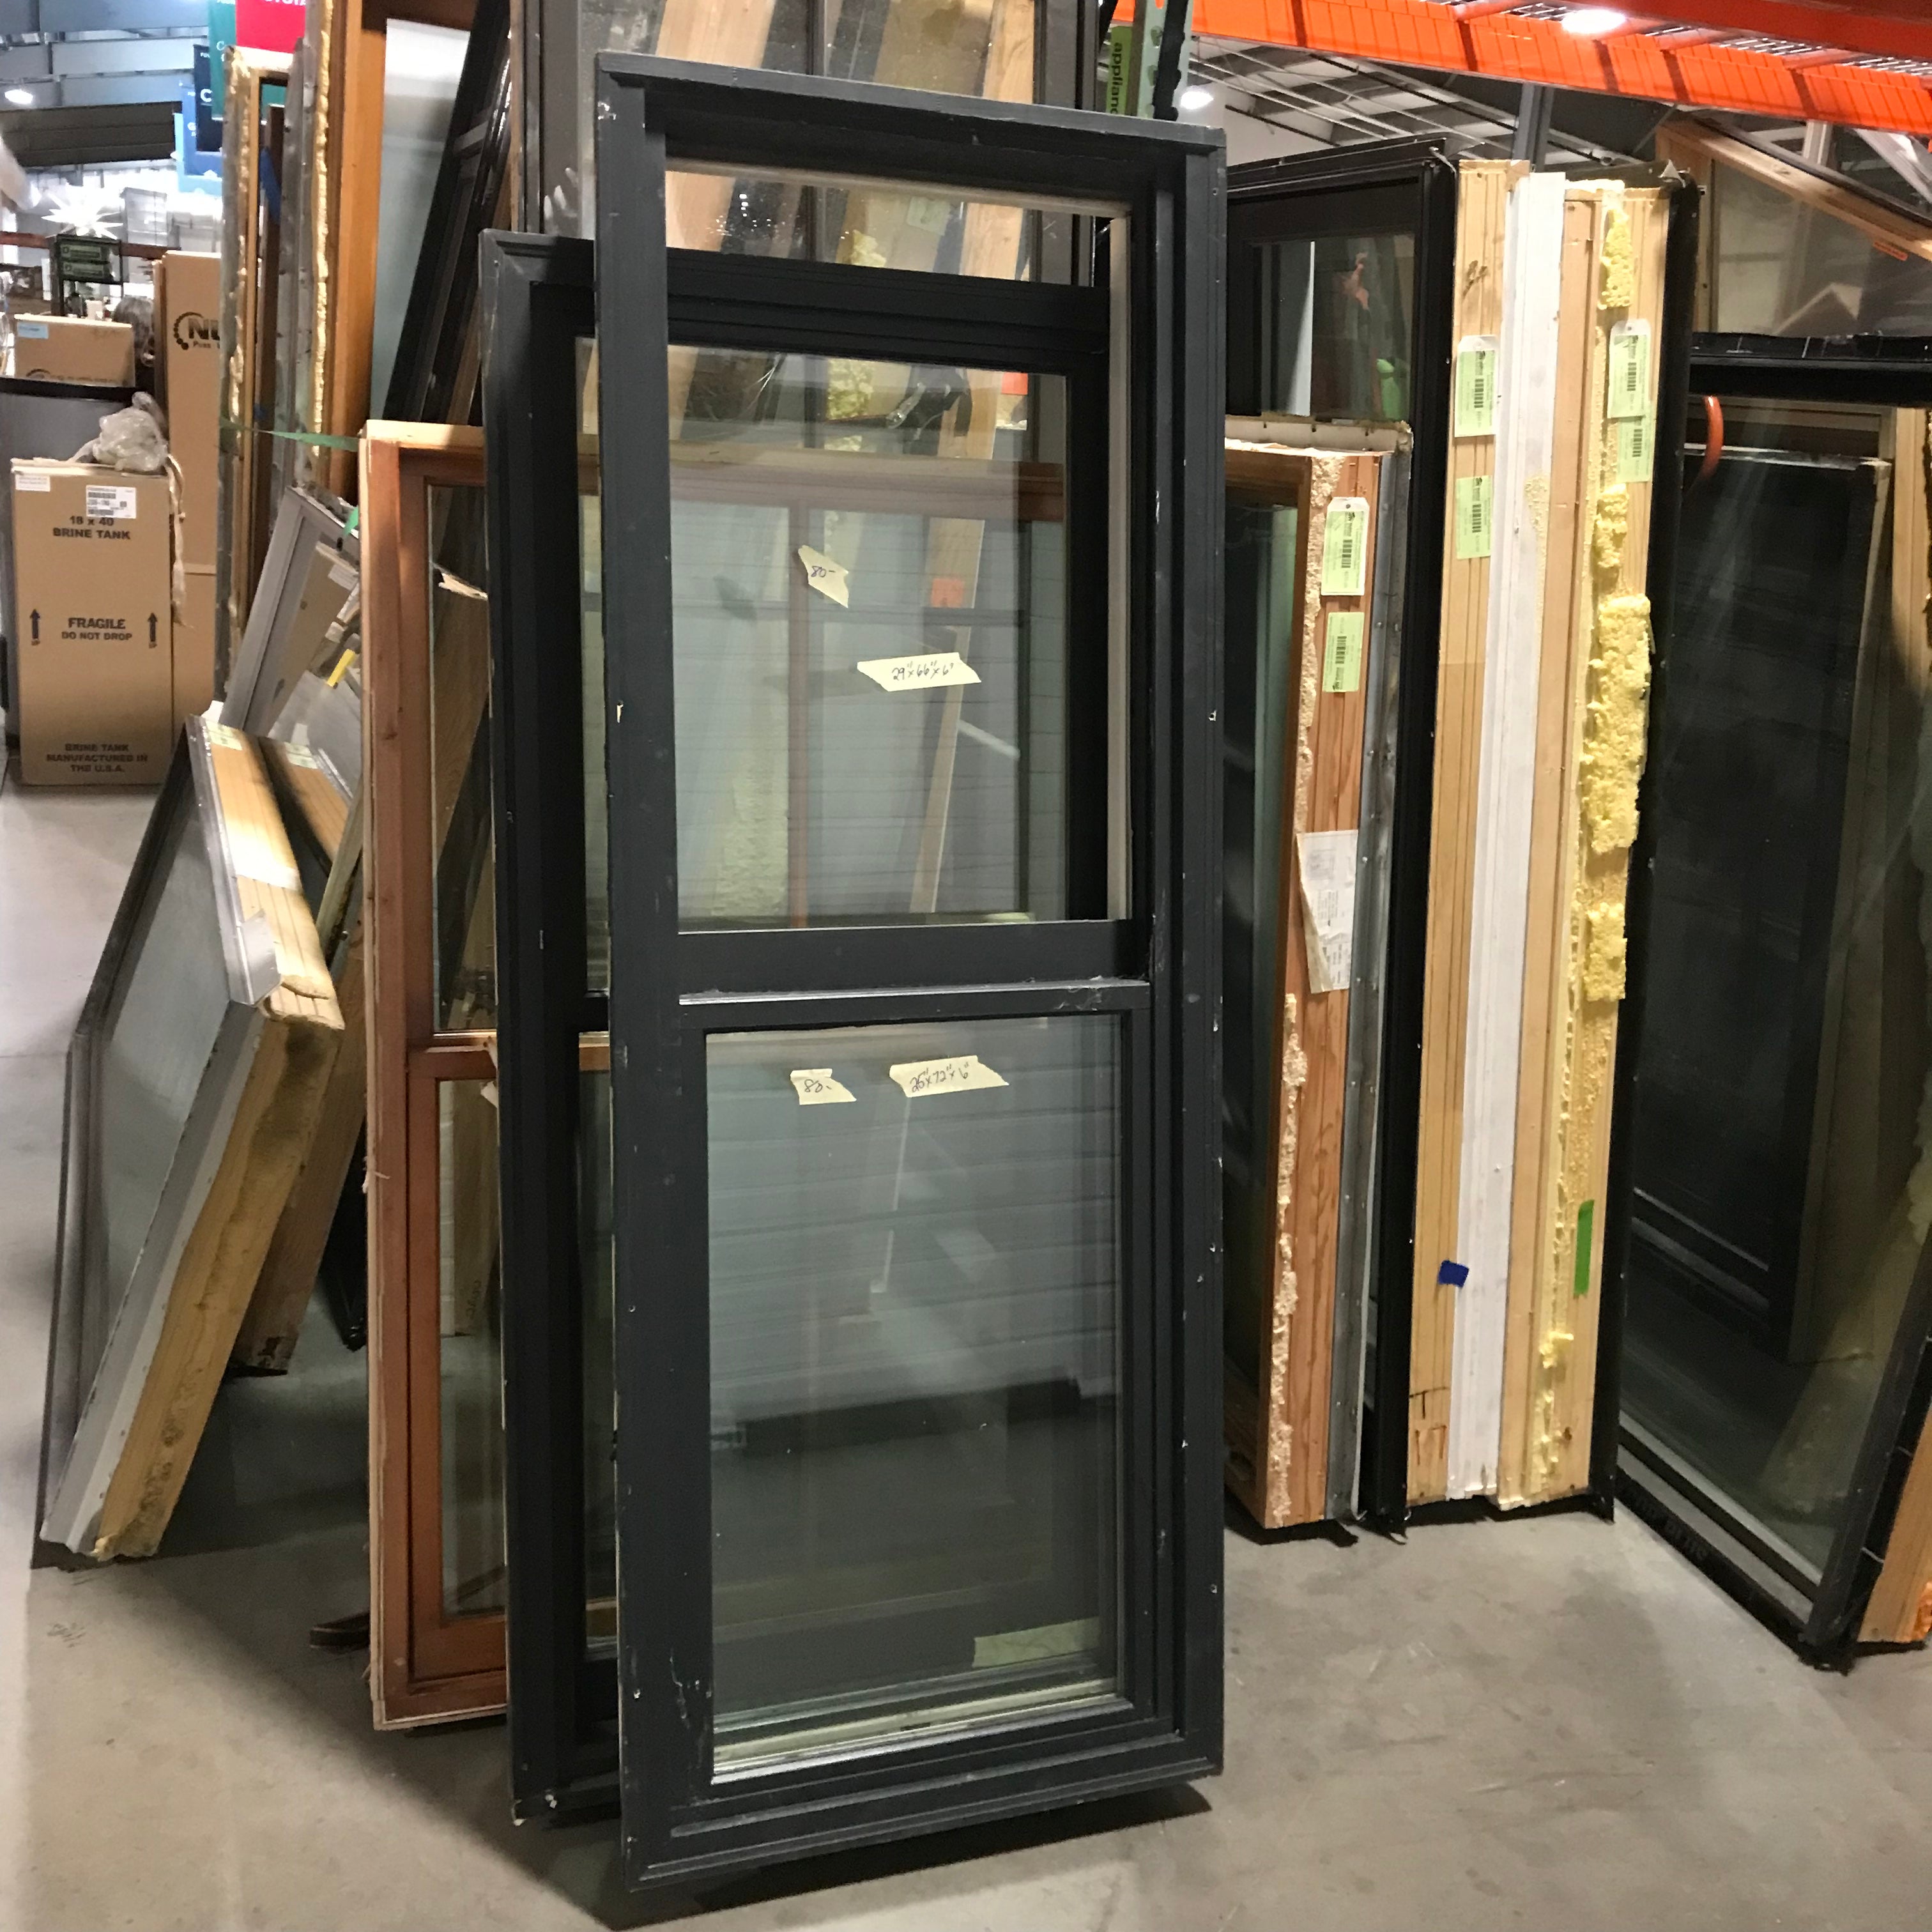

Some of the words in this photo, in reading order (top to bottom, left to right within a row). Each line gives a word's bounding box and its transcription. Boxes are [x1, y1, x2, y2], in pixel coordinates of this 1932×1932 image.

[70, 516, 84, 525] 18
[99, 517, 114, 526] 40
[52, 527, 93, 538] BRINE
[96, 530, 131, 540] TANK
[68, 617, 126, 629] FRAGILE
[61, 631, 77, 640] DO
[80, 632, 100, 640] NOT
[103, 632, 133, 641] DROP
[65, 743, 97, 751] BRINE
[46, 754, 134, 762] MANUFACTURED
[136, 754, 148, 762] IN
